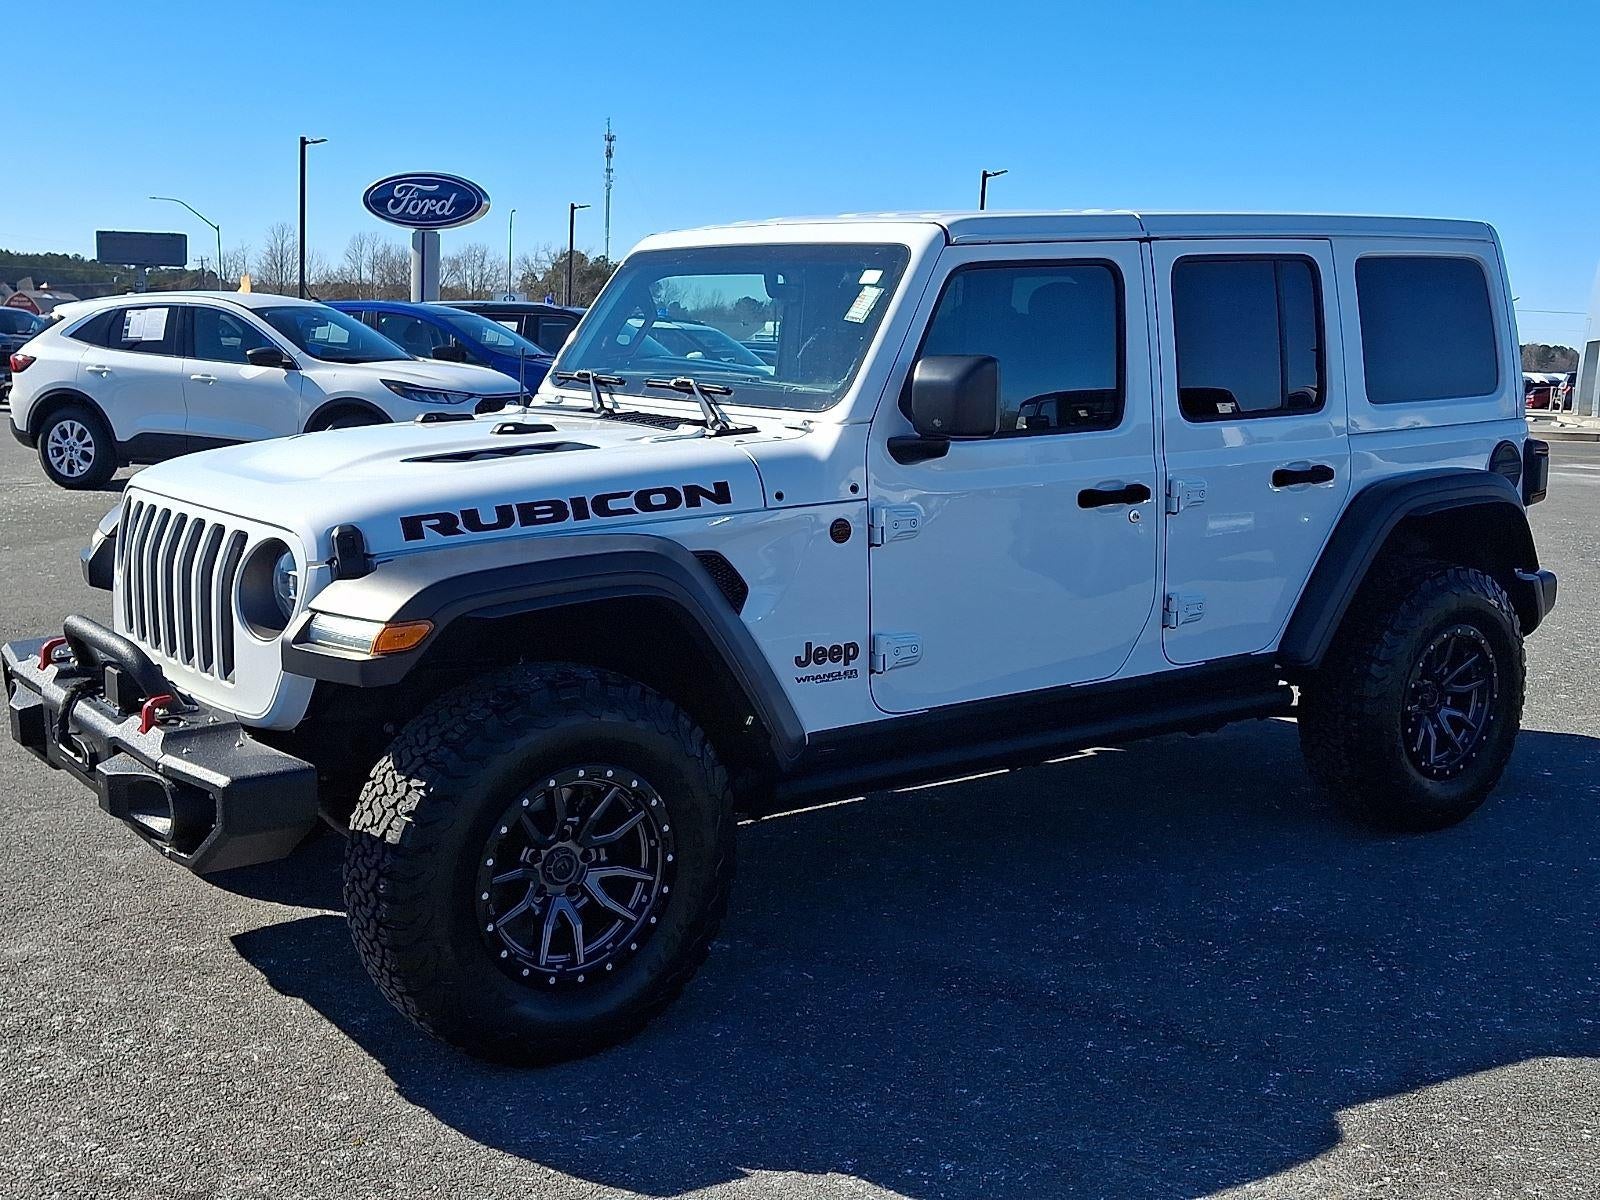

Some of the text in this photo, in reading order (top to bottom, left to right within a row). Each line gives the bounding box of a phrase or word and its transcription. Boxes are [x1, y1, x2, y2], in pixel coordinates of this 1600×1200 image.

[387, 183, 458, 216] Ford
[399, 480, 732, 542] RUBICON
[794, 641, 860, 669] Jeep
[794, 669, 858, 684] WRANGLER
